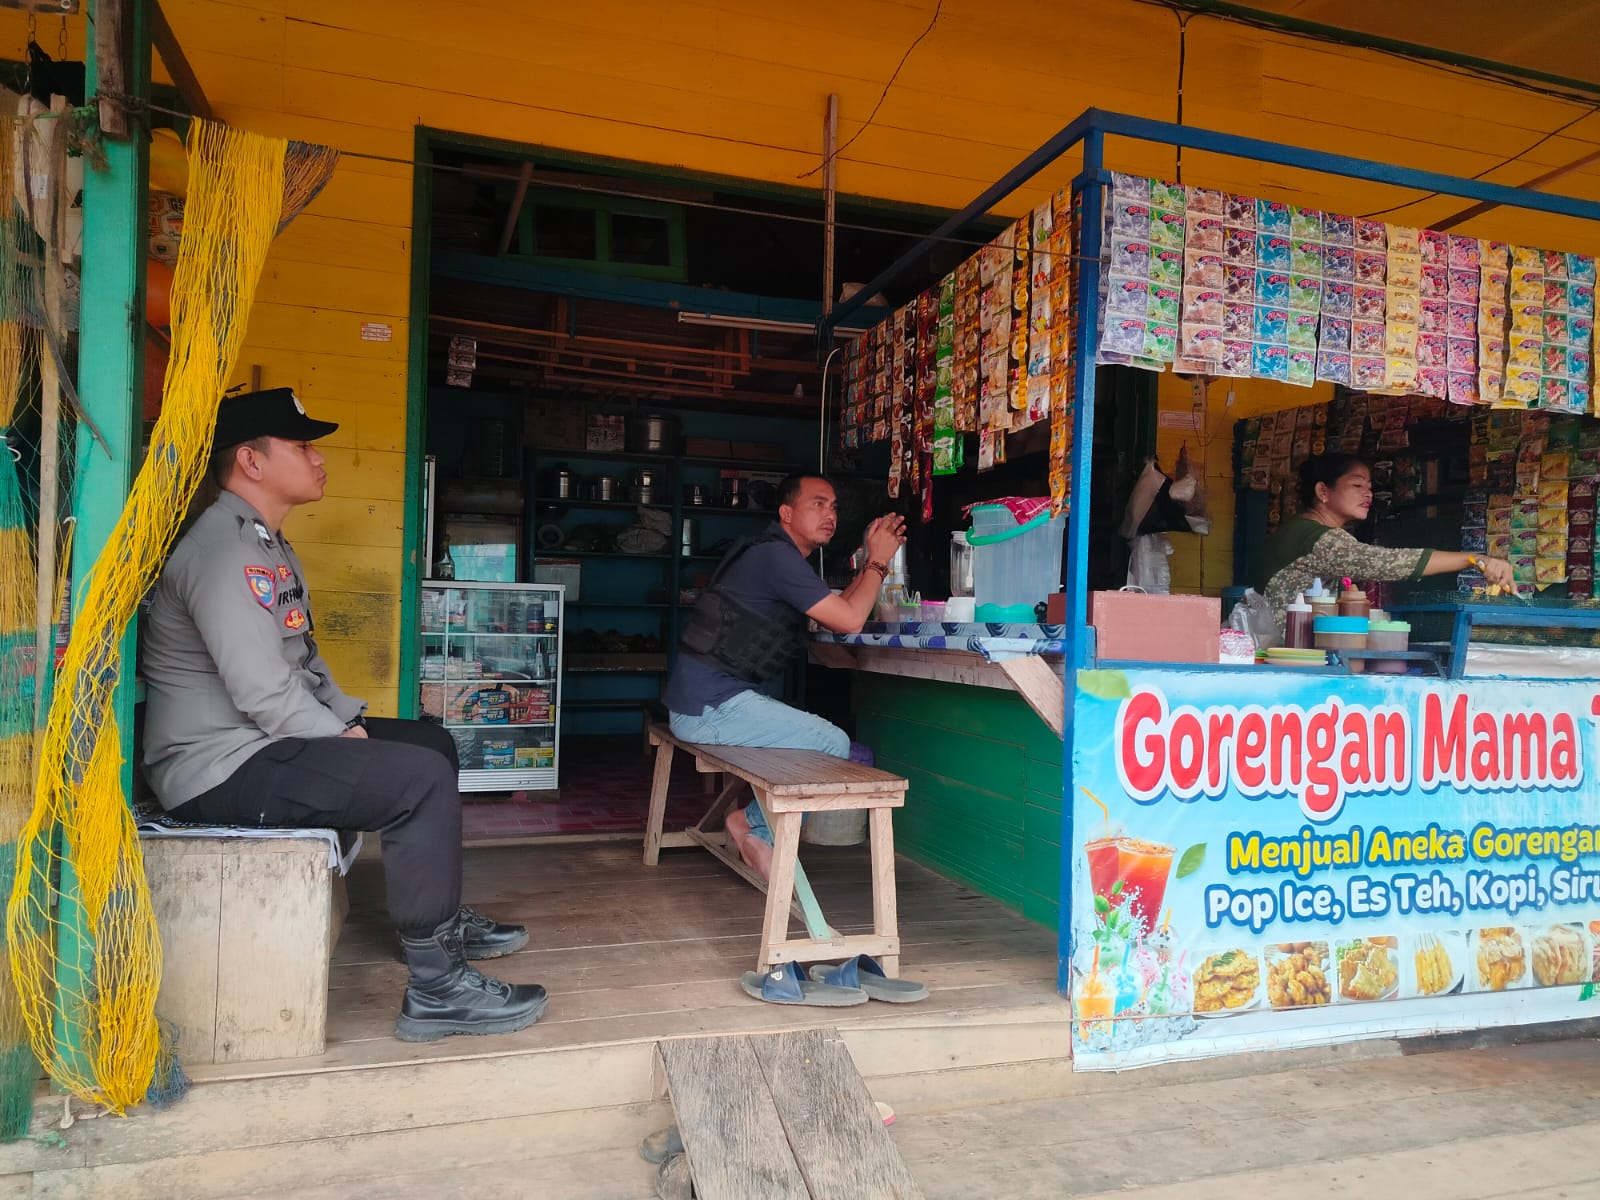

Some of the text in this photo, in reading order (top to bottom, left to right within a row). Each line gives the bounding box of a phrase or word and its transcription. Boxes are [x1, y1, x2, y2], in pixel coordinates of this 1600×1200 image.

[1120, 690, 1579, 812] Gorengan Mama
[1230, 830, 1360, 875] Menjual
[1368, 827, 1465, 862] Aneka
[1209, 889, 1274, 929] Pop
[1284, 885, 1342, 920] Ice,
[1350, 880, 1388, 913] Es
[1394, 874, 1461, 912] Teh,
[1468, 868, 1545, 912] Kopi,
